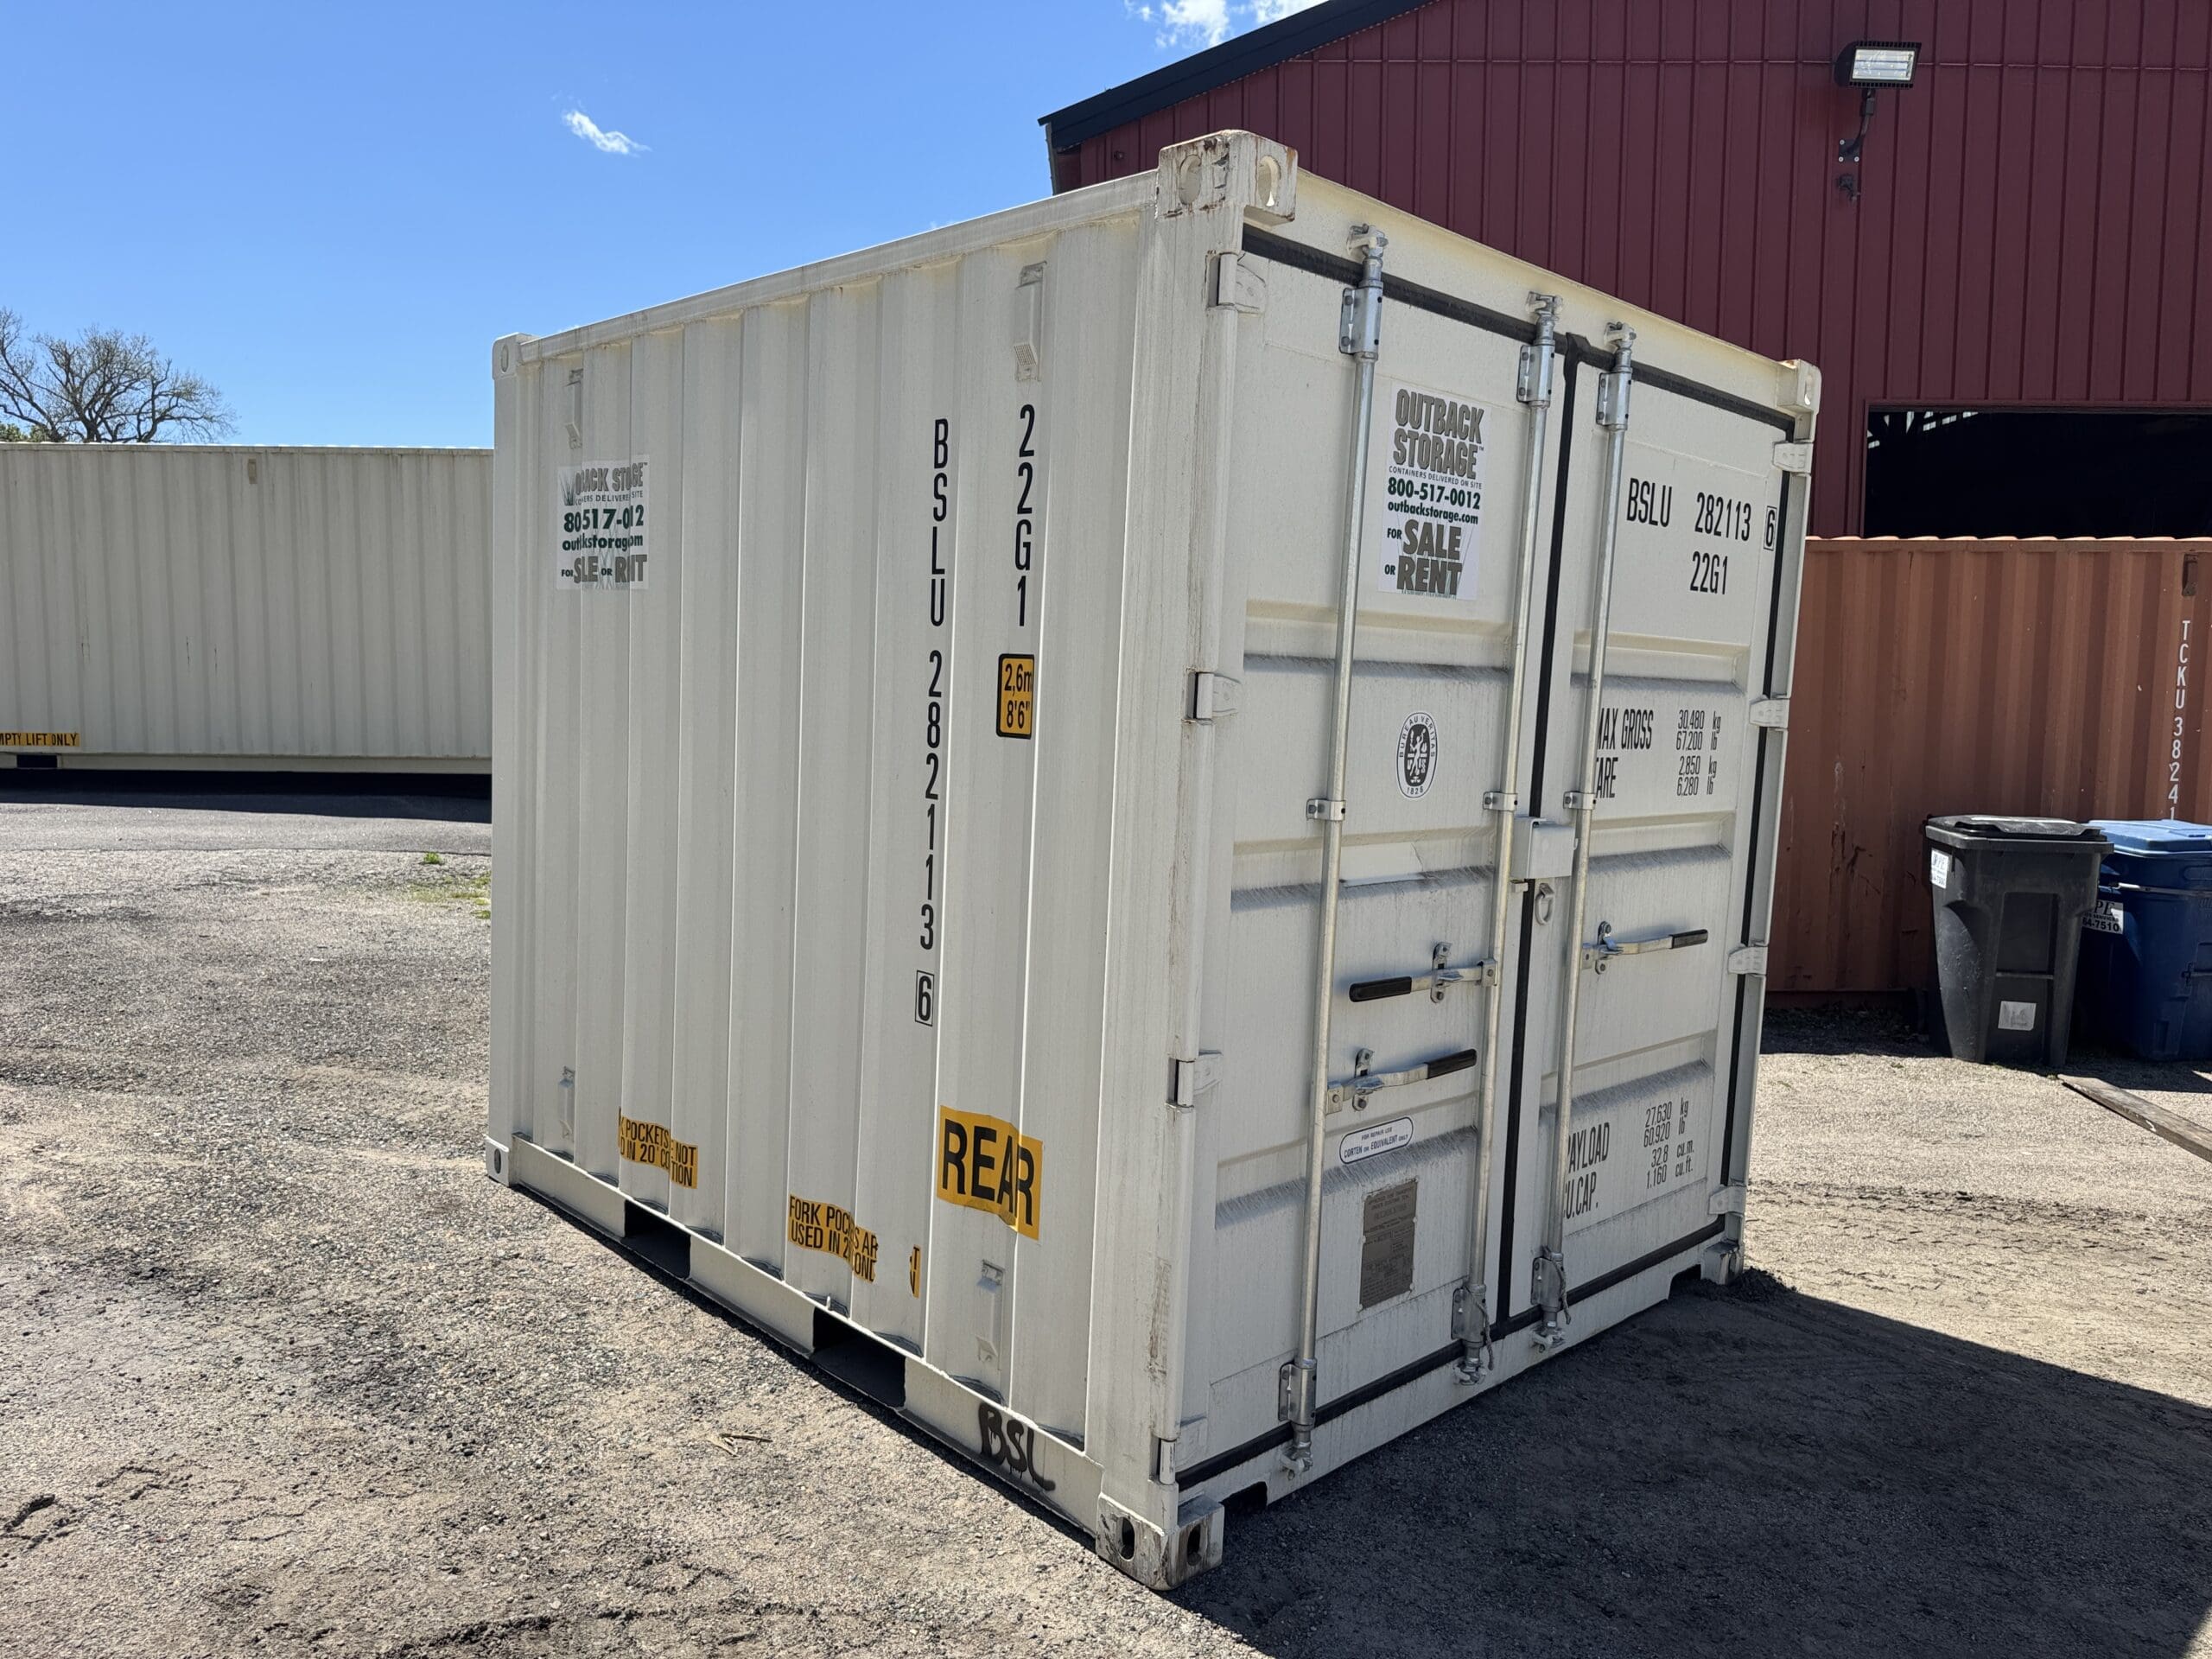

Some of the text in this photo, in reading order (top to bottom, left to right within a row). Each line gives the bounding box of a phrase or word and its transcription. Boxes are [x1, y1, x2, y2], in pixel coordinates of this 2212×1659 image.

[1395, 389, 1484, 444] OUTBACK
[1393, 428, 1478, 480] STORAGE
[1388, 476, 1481, 510] 800-517-0012
[1389, 466, 1427, 479] CONTAINERS
[1428, 473, 1459, 486] DELIVERED
[1015, 404, 1035, 626] 22G1
[1388, 499, 1478, 524] outbackstorage.com
[1626, 477, 1777, 549] BSLU 282113 6
[1387, 518, 1461, 560] FOR SALE
[601, 568, 613, 576] OR
[1384, 555, 1463, 595] OR RENT
[1690, 550, 1728, 594] 22G1
[2176, 620, 2190, 709] TCKU
[917, 418, 948, 1025] BSLU 282113 6
[1399, 715, 1435, 757] BUREAU VERITAS
[1621, 709, 1654, 749] GROSS
[1713, 710, 1721, 734] kg
[26, 733, 48, 746] LIFT
[52, 733, 77, 747] ONLY
[1711, 732, 1718, 750] lb
[1708, 756, 1717, 778] kg
[1707, 776, 1713, 795] lb
[1680, 1097, 1688, 1117] kg
[626, 1118, 669, 1149] POCKETS
[676, 1141, 696, 1166] NOT
[1678, 1116, 1685, 1135] lb
[626, 1140, 636, 1160] IN
[1344, 1146, 1363, 1158] CORTEN
[1370, 1135, 1397, 1150] EQUIVALENT
[1651, 1144, 1669, 1167] 32.8
[943, 1118, 1034, 1226] REAR
[790, 1195, 821, 1225] FORK
[791, 1220, 823, 1249] USED
[829, 1230, 841, 1254] IN
[978, 1402, 1056, 1491] BSL
